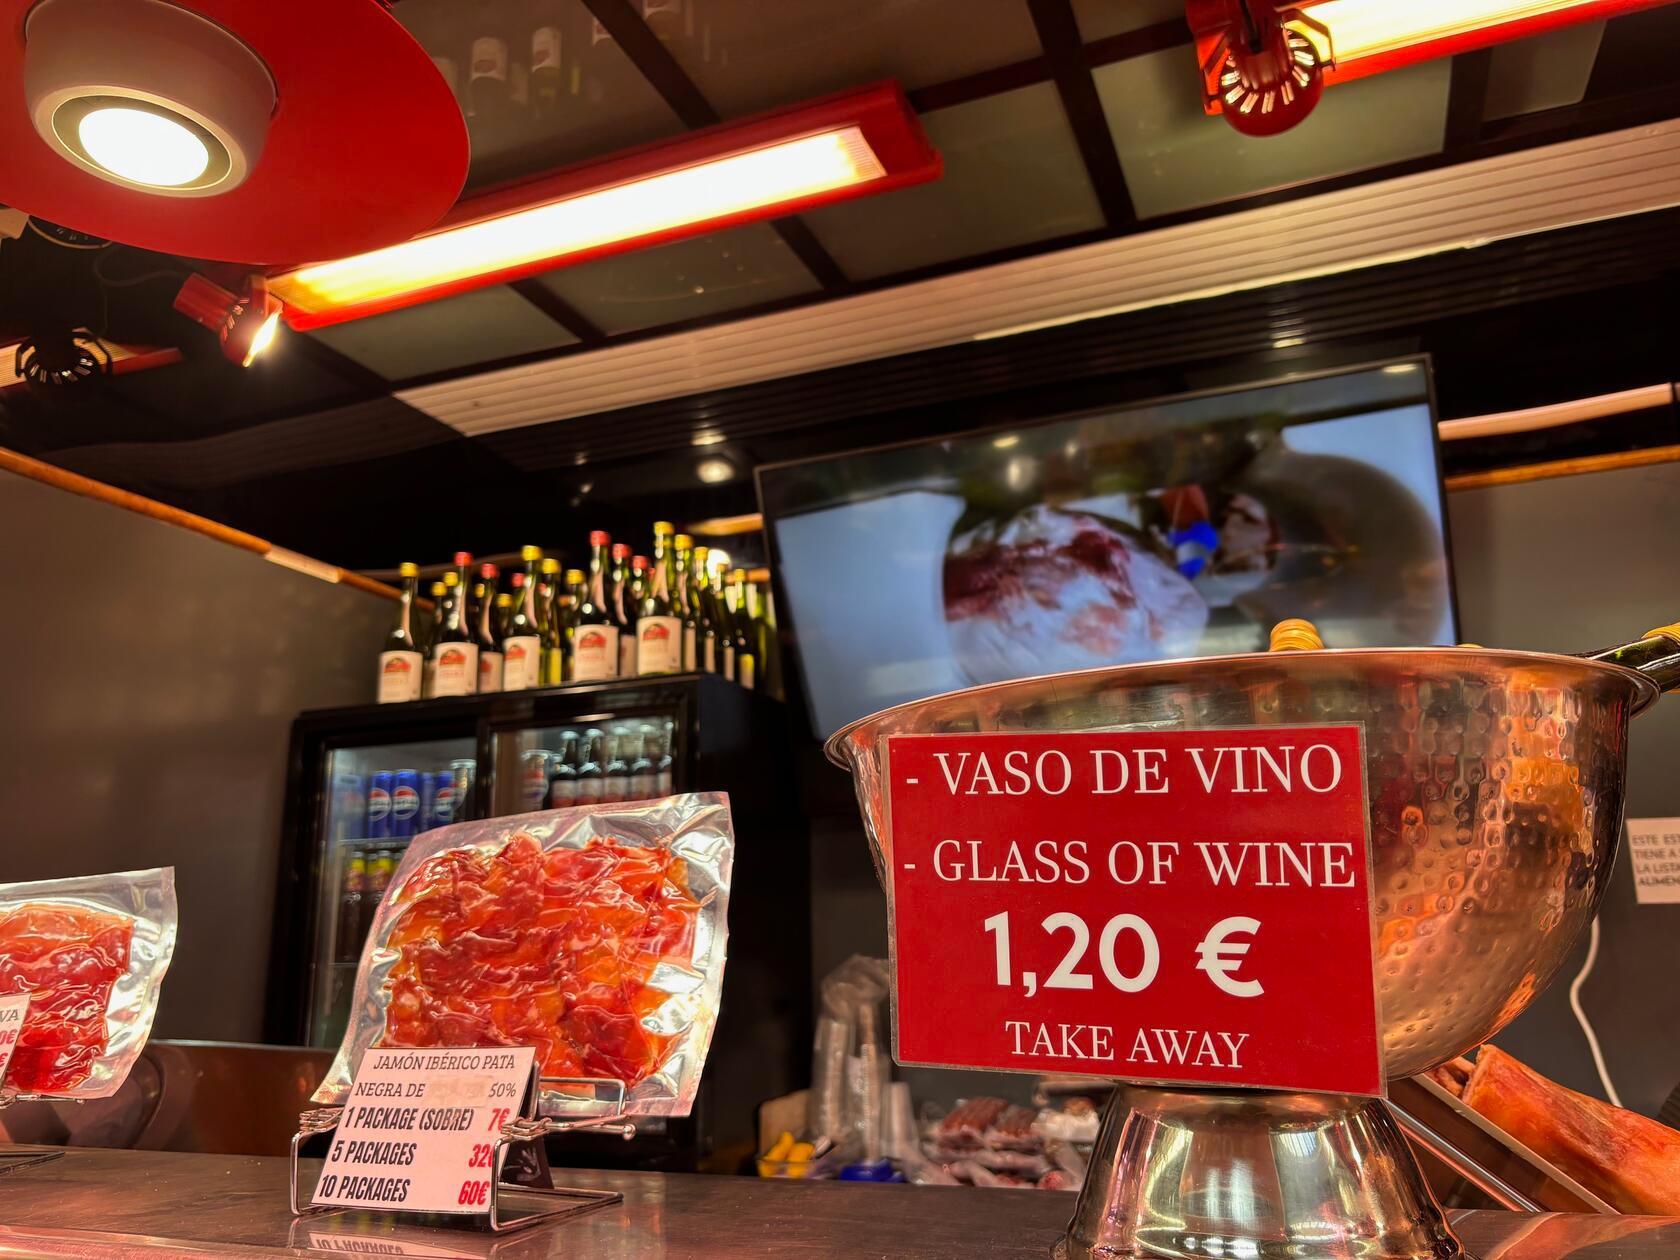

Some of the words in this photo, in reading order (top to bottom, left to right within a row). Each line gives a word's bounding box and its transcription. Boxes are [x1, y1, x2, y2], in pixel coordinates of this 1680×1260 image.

[933, 750, 1072, 795] VASO
[1090, 748, 1169, 794] DE
[1184, 744, 1342, 794] VINO
[933, 839, 1090, 884] GLASS
[1108, 840, 1180, 885] OF
[1193, 842, 1355, 888] WINE
[984, 911, 1160, 998] 1,20
[1195, 916, 1265, 998] €
[1005, 1021, 1114, 1061] TAKE
[1126, 1027, 1250, 1068] AWAY
[373, 1052, 425, 1070] JAMÓN
[425, 1052, 481, 1070] IBÉRICO
[482, 1054, 515, 1070] PATA
[354, 1082, 402, 1098] NEGRA
[405, 1083, 426, 1098] DE
[488, 1082, 517, 1098] 50%
[345, 1106, 356, 1128] 1
[353, 1106, 418, 1131] PACKAGE
[419, 1107, 475, 1131] (SOBRE)
[331, 1140, 345, 1163] 5
[344, 1140, 418, 1166] PACKAGES
[319, 1174, 338, 1198] 10
[336, 1175, 411, 1203] PACKAGES
[457, 1180, 490, 1206] 60€
